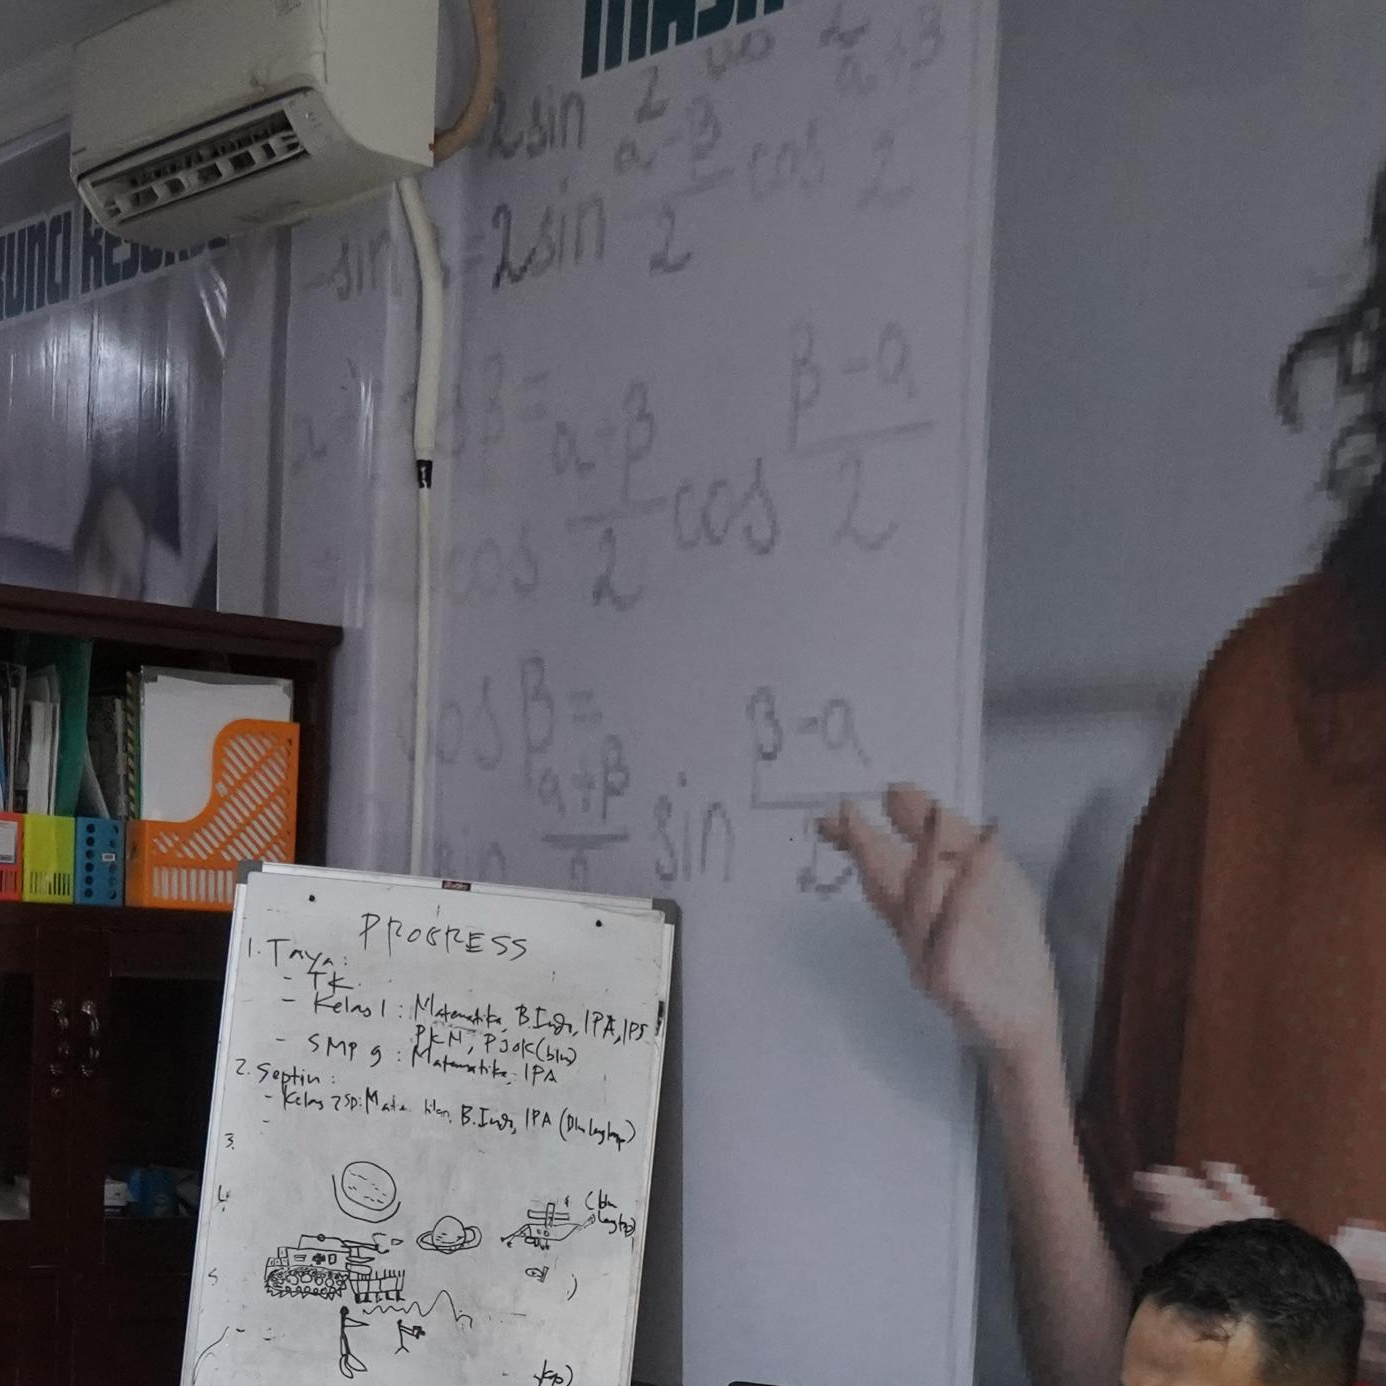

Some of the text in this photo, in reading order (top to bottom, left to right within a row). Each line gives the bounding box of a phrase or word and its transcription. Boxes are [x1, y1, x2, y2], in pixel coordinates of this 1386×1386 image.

[359, 913, 528, 961] PROGRESS
[308, 1034, 357, 1061] SMP
[524, 1063, 558, 1087] IPA
[525, 1107, 551, 1129] IPA
